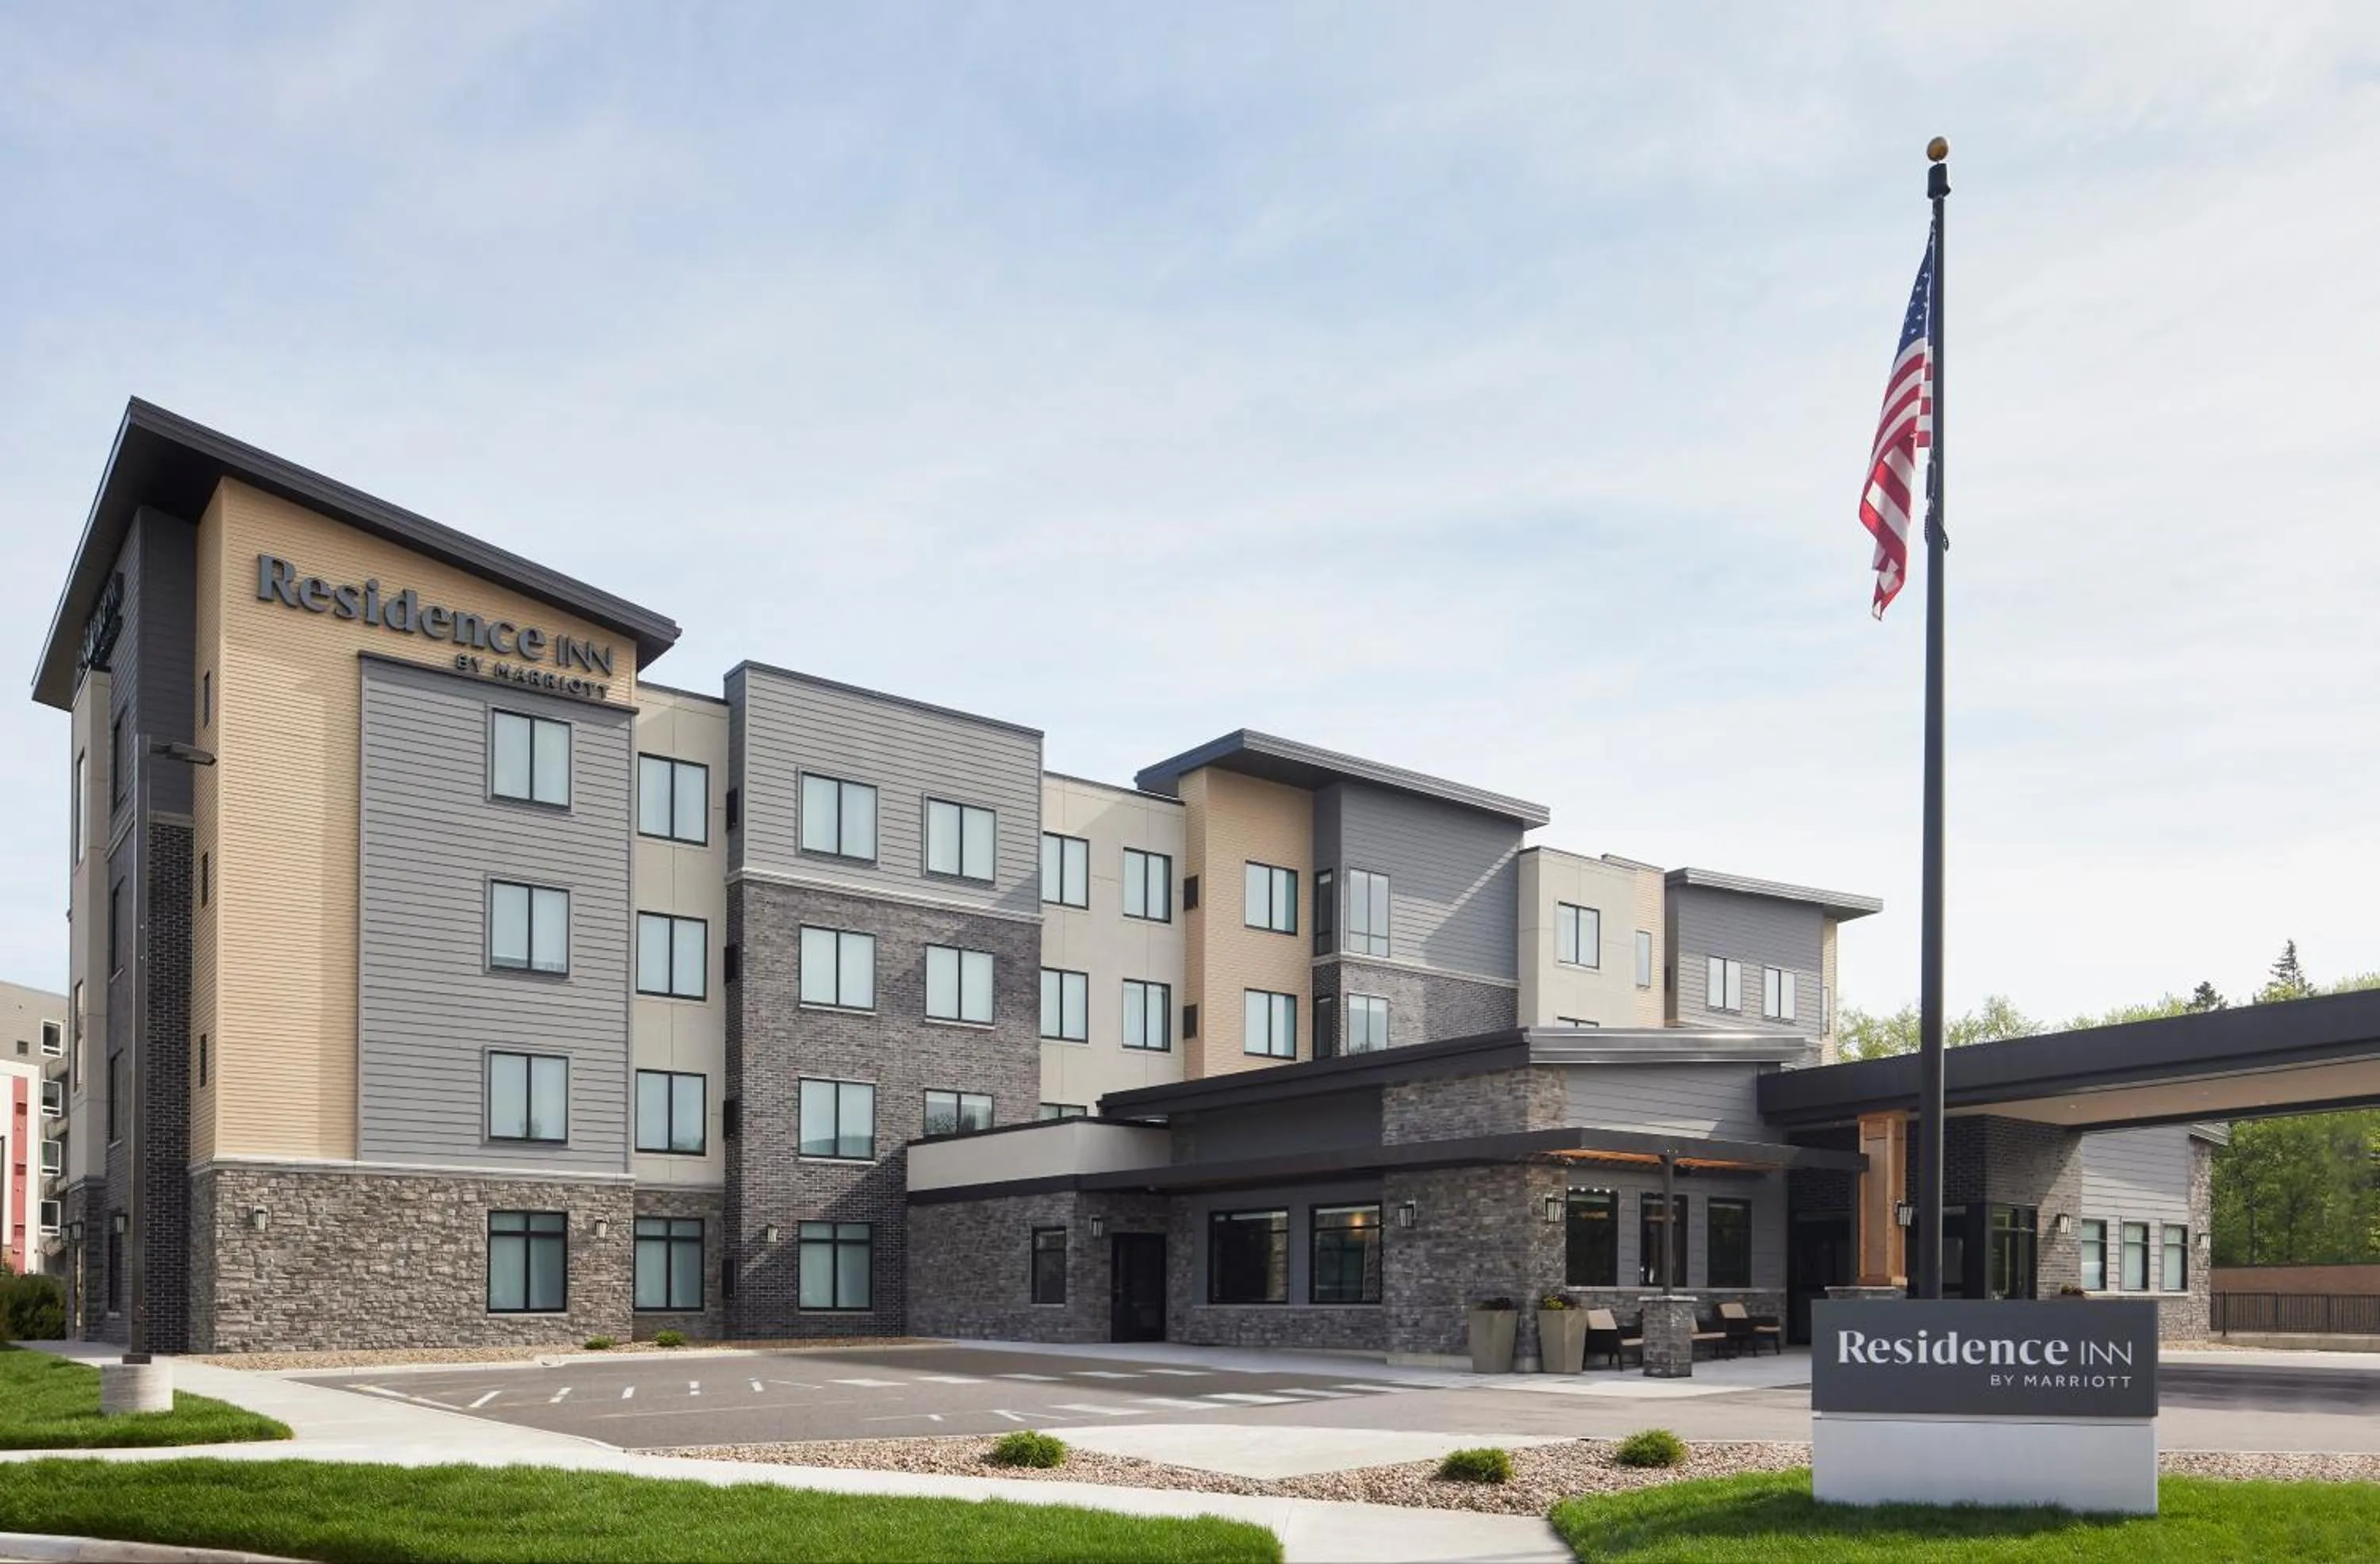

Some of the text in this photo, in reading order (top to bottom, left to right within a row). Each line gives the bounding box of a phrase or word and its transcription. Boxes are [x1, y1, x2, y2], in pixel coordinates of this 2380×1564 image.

[257, 554, 613, 676] Residence INN
[456, 653, 610, 700] BY MARRIOTT
[1837, 1329, 2132, 1367] Residence INN
[1990, 1374, 2132, 1389] BY MARRIOTT
